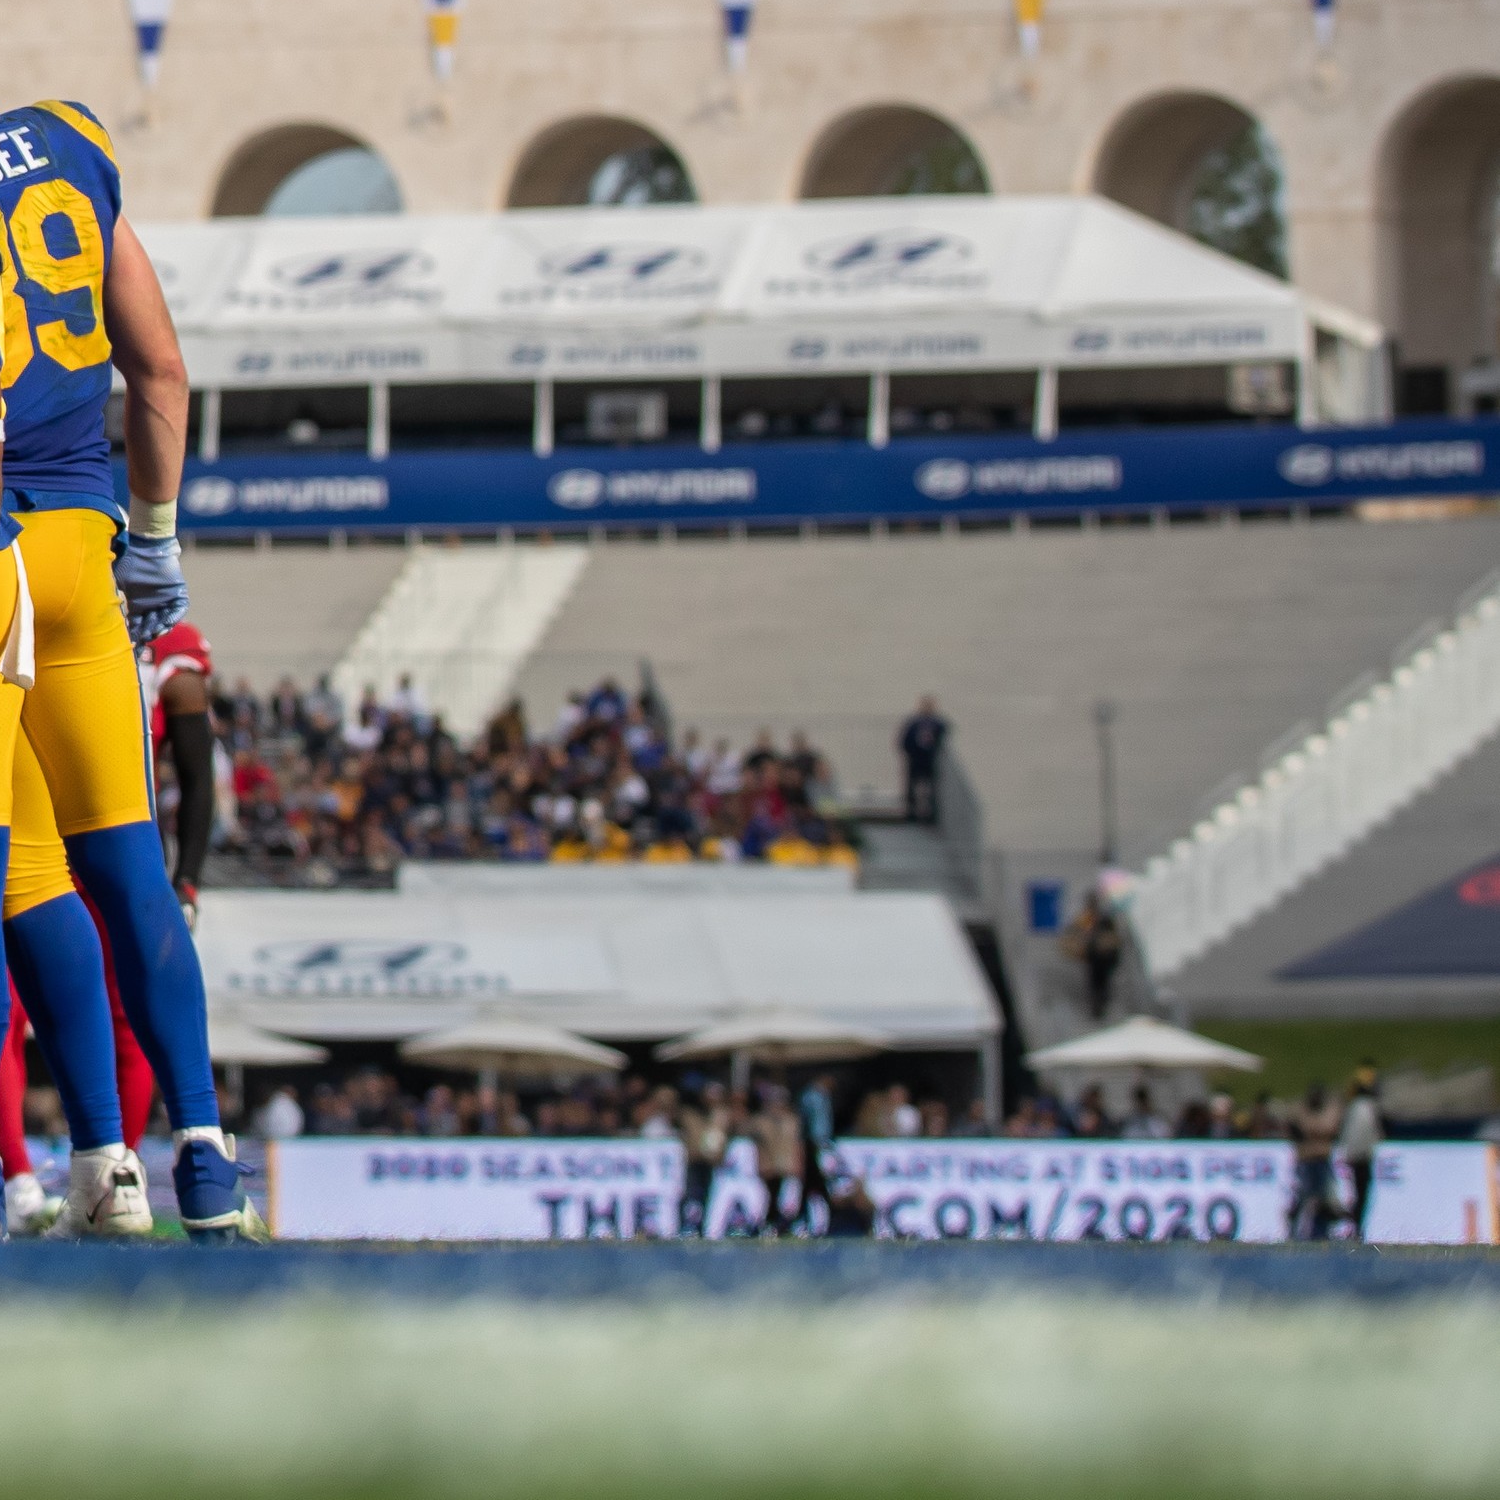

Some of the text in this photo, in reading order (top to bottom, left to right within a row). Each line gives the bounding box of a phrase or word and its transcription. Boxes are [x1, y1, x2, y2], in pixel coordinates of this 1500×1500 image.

[481, 1153, 645, 1182] SEASON
[852, 1153, 1031, 1183] TARTING
[1042, 1153, 1085, 1183] AT
[1204, 1153, 1277, 1183] PER
